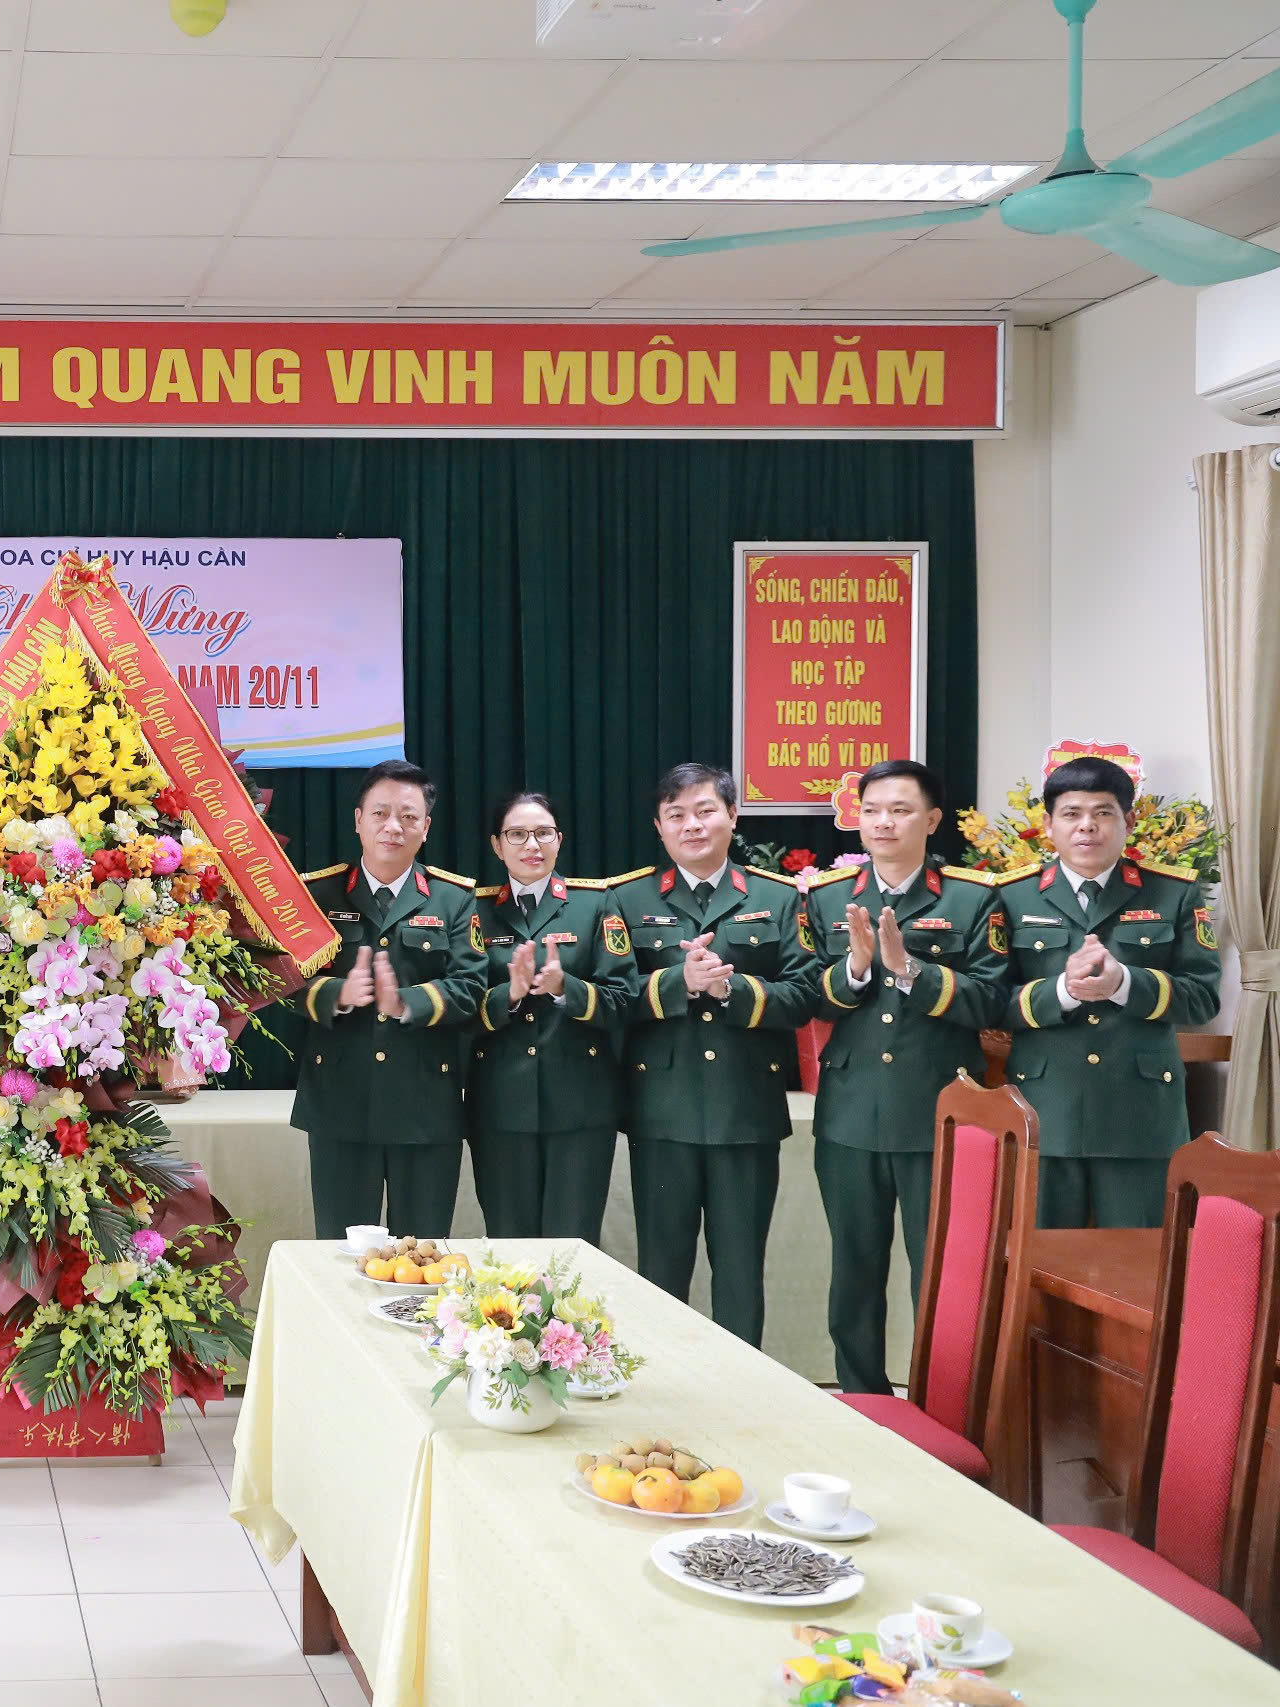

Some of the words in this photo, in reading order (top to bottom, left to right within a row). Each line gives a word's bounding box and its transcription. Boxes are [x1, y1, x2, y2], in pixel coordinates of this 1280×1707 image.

[53, 347, 301, 410] QUANG
[327, 350, 494, 406] VINH
[524, 335, 738, 407] MUÔN
[770, 335, 946, 406] NĂM
[142, 547, 190, 570] HẬU
[197, 546, 246, 567] CẦN
[755, 569, 805, 606] SỐNG,
[809, 569, 859, 603] CHIẾN
[865, 569, 904, 606] ĐẤU,
[119, 581, 251, 654] Mừng
[772, 619, 803, 644] LAO
[809, 613, 855, 649] ĐỘNG
[865, 614, 887, 644] VÀ
[0, 651, 39, 691] HẬU
[248, 664, 319, 707] 20/11
[791, 660, 825, 690] HỌC
[834, 655, 866, 690] TẬP
[776, 700, 817, 726] THEO
[825, 699, 882, 726] GƯƠNG
[767, 737, 801, 767] BÁC
[808, 733, 830, 767] HỒ
[838, 737, 856, 767] VĨ
[108, 642, 147, 690] Mừng
[140, 687, 178, 739] Ngày
[171, 737, 206, 780] Nhà
[190, 779, 228, 819] Giáo
[223, 819, 257, 859] Việt
[246, 856, 280, 903] Nam
[19, 1419, 131, 1448] 情人节快乐
